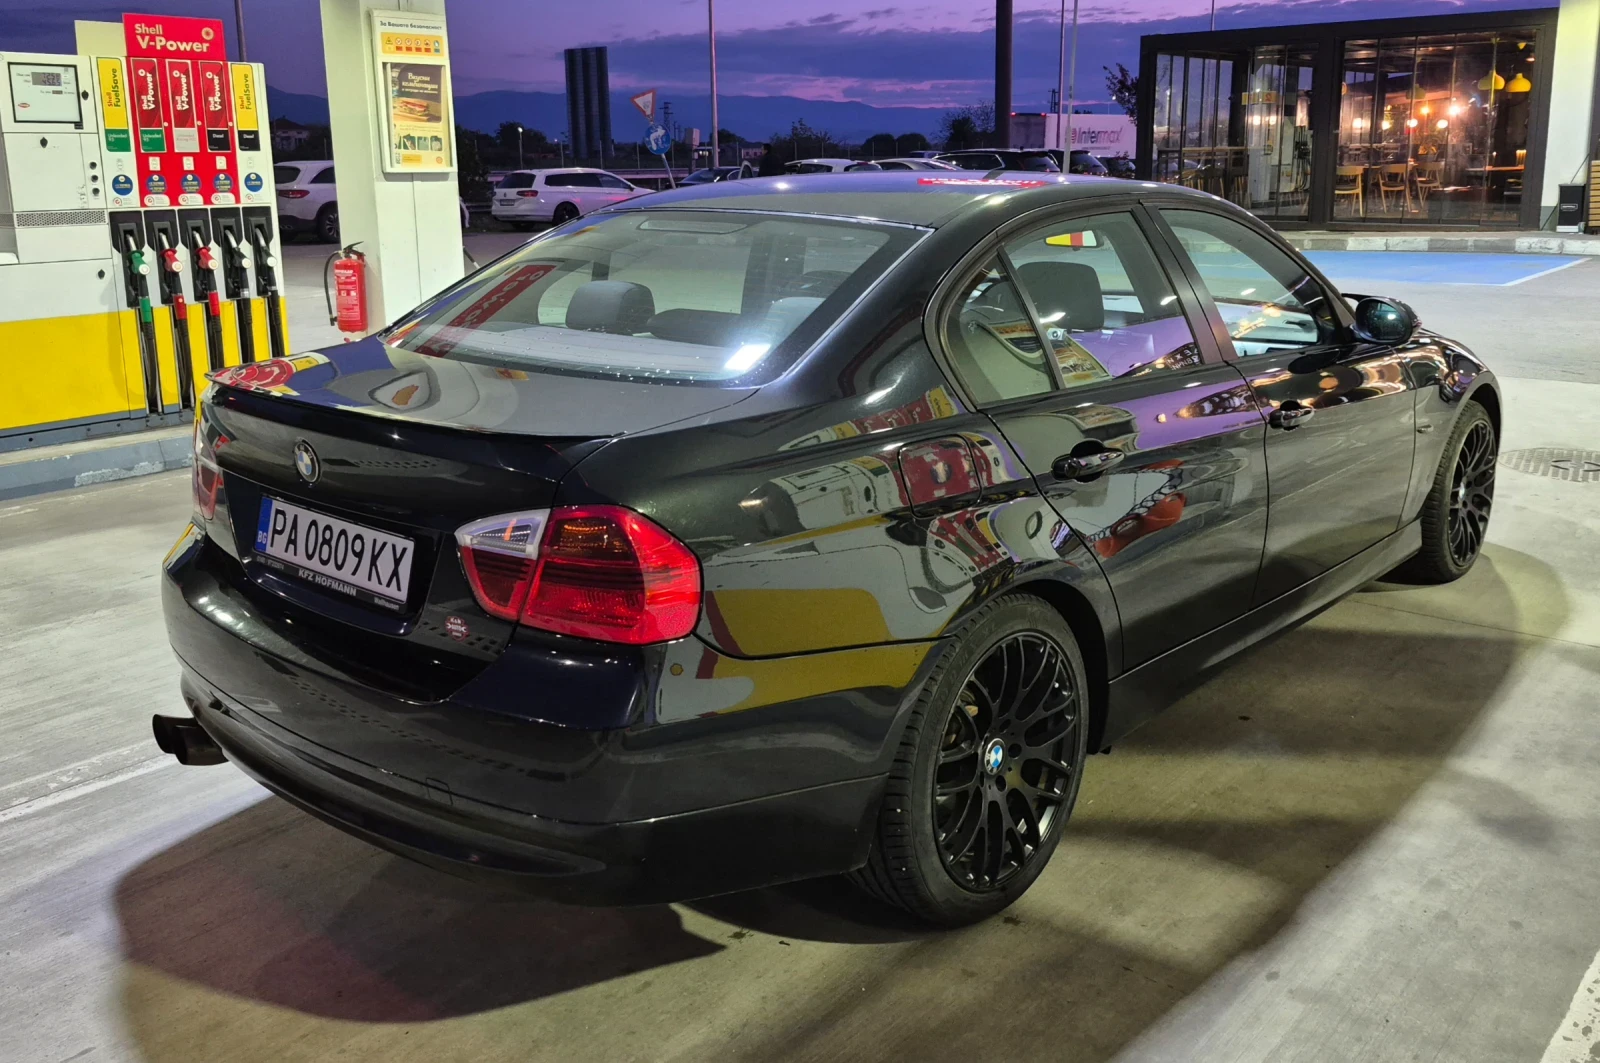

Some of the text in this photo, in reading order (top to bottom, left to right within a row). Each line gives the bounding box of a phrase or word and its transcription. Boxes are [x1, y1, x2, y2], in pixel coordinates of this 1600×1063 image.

[134, 23, 163, 35] Shell
[136, 35, 210, 52] V-Power
[112, 68, 121, 107] FuelSave
[146, 71, 156, 110] V-Power
[180, 73, 189, 110] V-Power
[213, 74, 222, 111] V-Power
[243, 73, 252, 110] FuelSave
[257, 530, 268, 543] BG
[298, 568, 357, 597] KFZ HOFMANN
